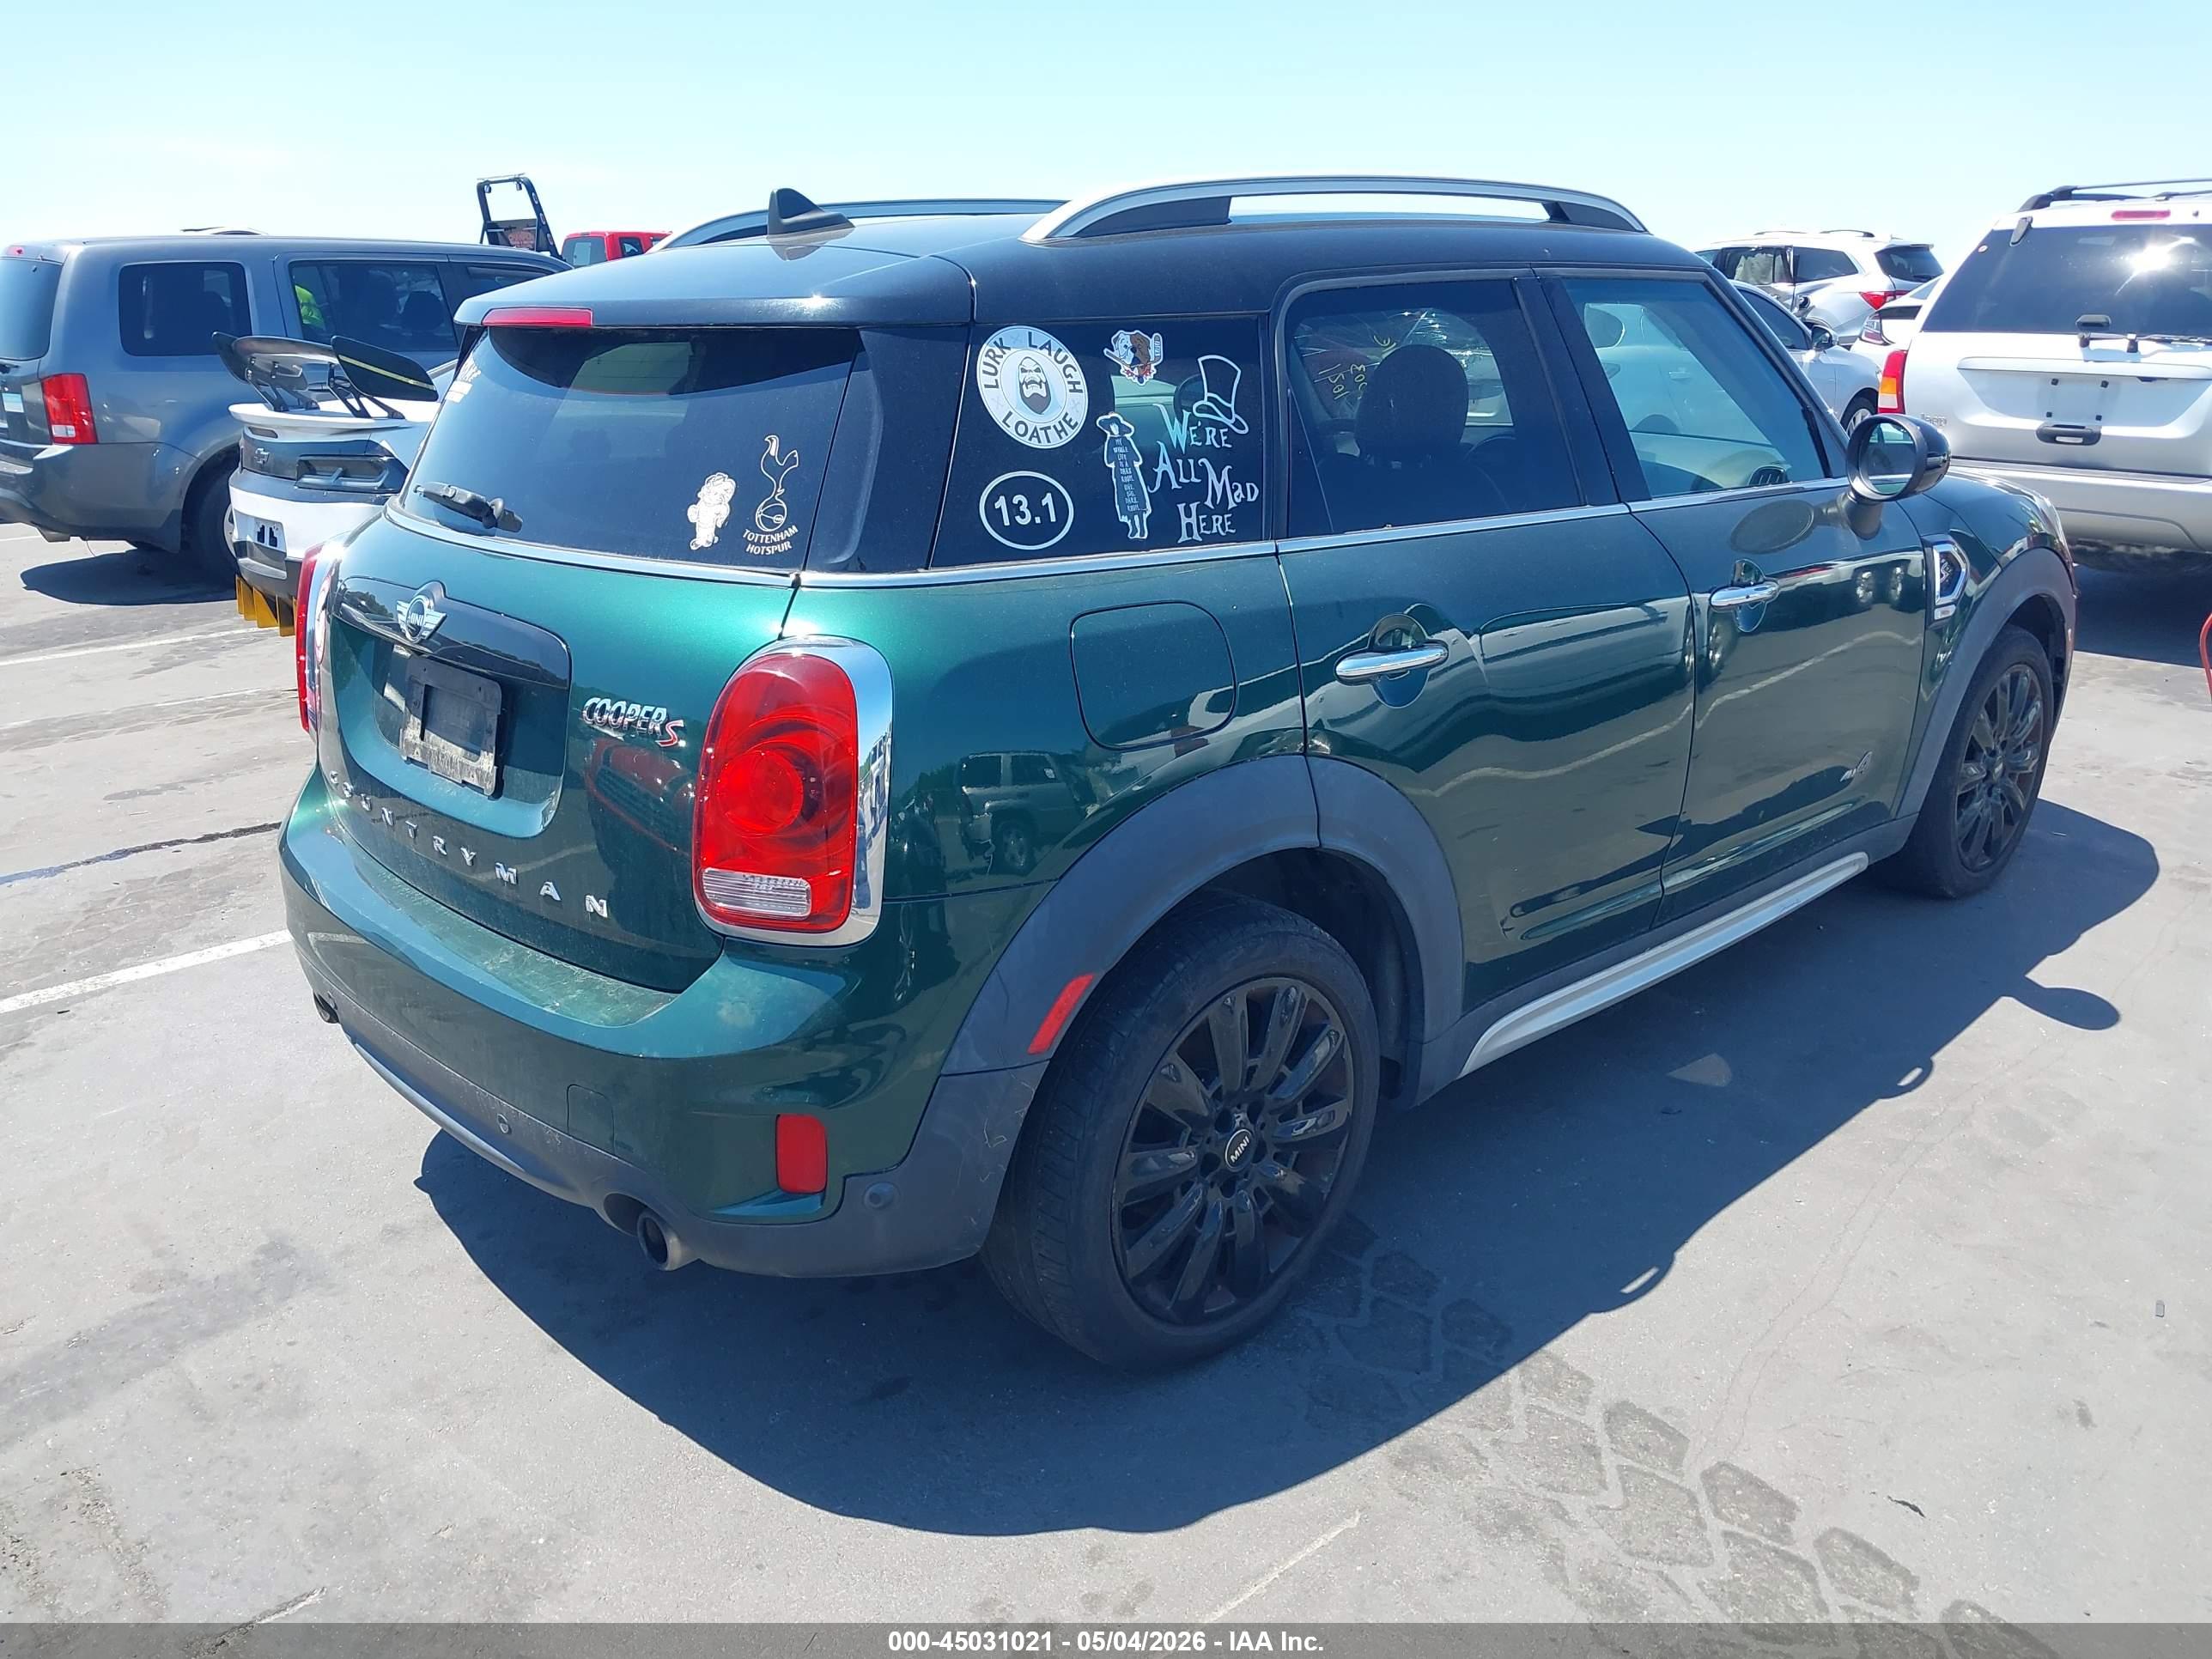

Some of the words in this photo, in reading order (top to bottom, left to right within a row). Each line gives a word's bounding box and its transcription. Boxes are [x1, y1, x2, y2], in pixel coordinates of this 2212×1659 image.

[981, 337, 1012, 389] LURK
[1028, 331, 1084, 394] LAUGH
[1001, 411, 1079, 444] LOATHE
[994, 492, 1056, 526] 13.1
[742, 525, 799, 544] TOTTENHAM
[745, 540, 793, 556] HOTSPUR
[582, 696, 668, 737] COOPER
[654, 720, 684, 747] S
[329, 770, 609, 919] COUNTRYMAN
[1230, 1135, 1250, 1163] MINI
